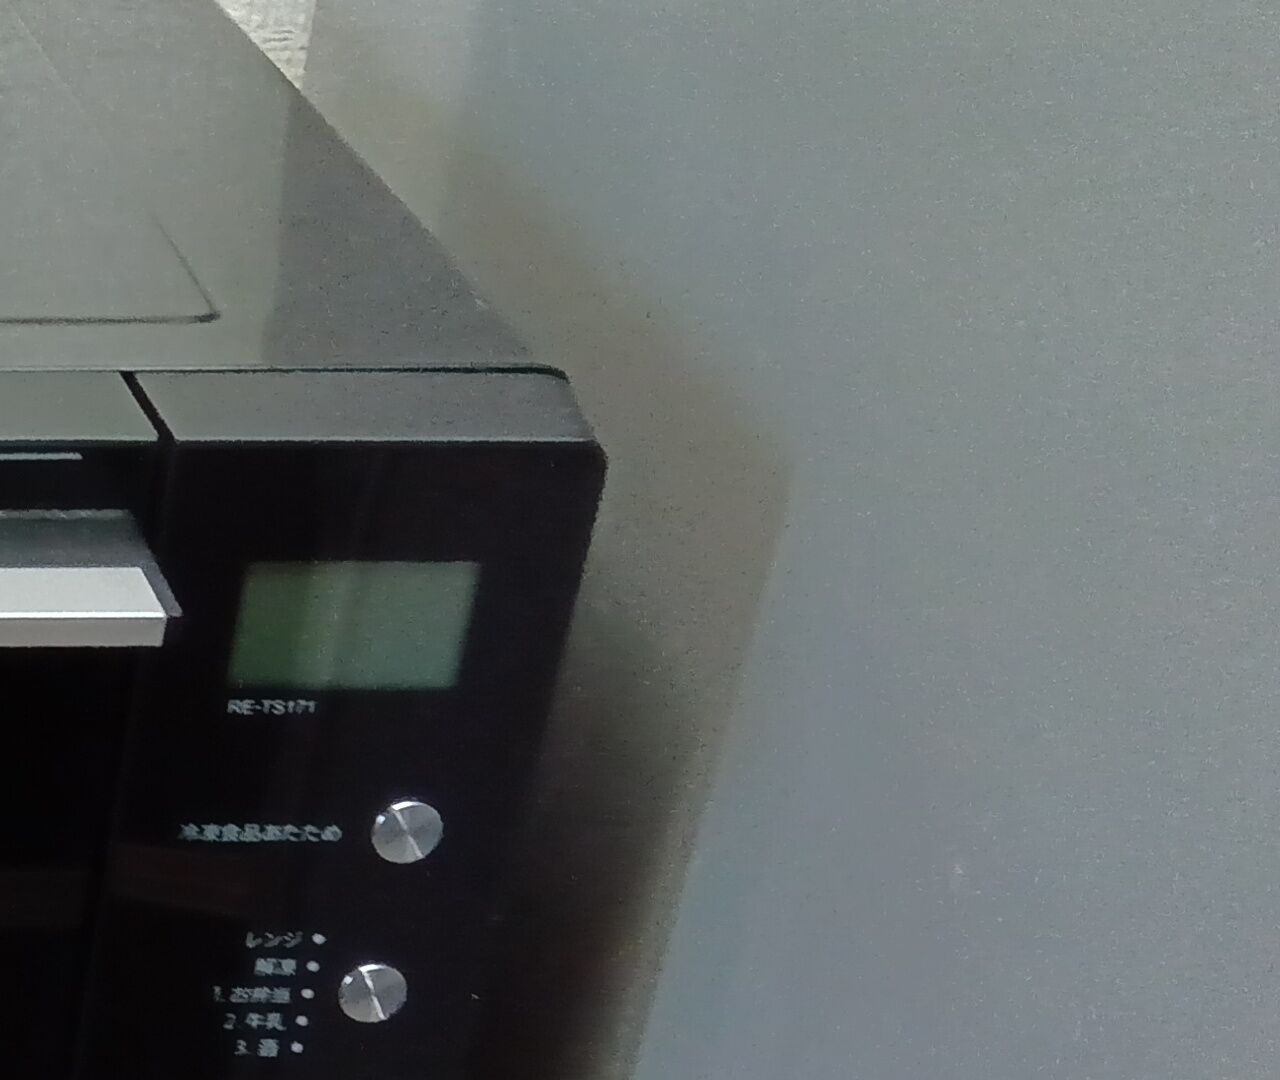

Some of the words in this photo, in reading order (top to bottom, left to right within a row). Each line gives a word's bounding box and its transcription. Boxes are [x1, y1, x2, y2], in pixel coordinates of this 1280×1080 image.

[226, 698, 317, 717] RE-TS171
[178, 822, 343, 844] 冷凍食品あたため
[244, 931, 304, 949] レンジ
